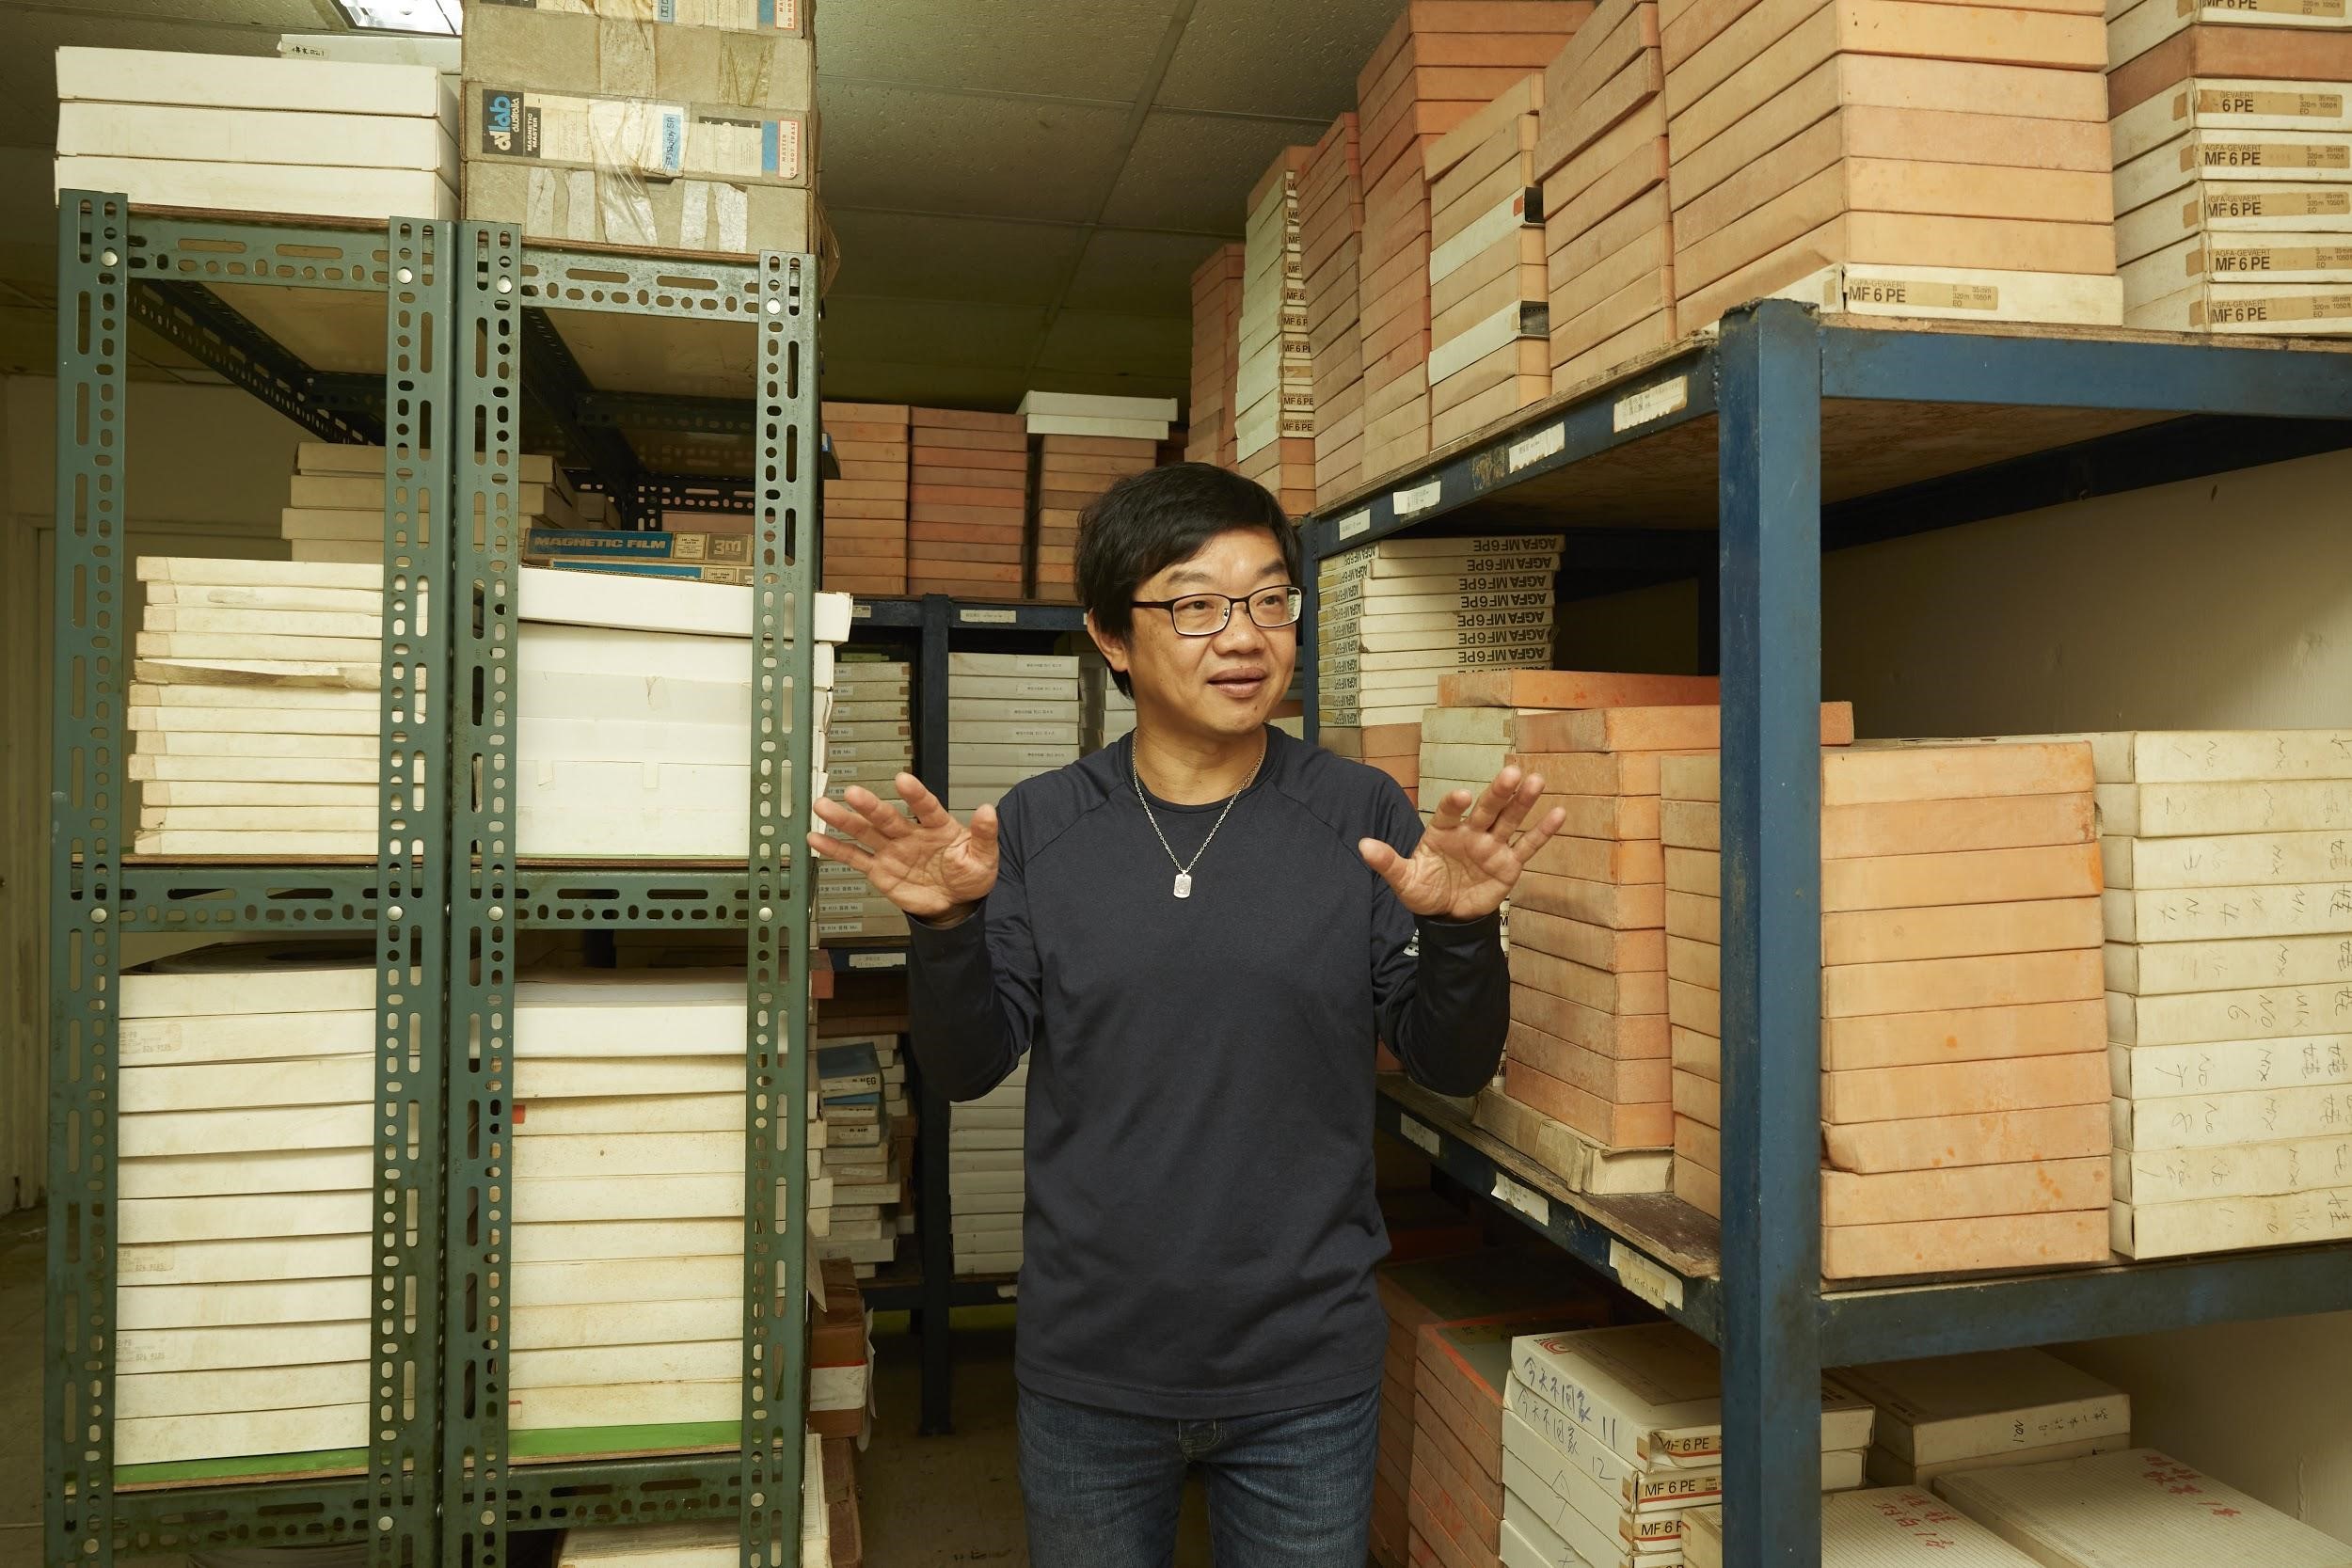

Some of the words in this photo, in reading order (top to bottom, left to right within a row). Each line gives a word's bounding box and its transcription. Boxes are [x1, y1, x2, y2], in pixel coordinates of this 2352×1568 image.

[2219, 90, 2254, 99] GEVAERT
[2222, 99, 2231, 112] 6
[2234, 99, 2254, 113] PE
[2204, 151, 2226, 166] MF
[2229, 151, 2237, 166] 6
[2241, 151, 2261, 166] PE
[2208, 202, 2227, 216] MF
[2230, 202, 2238, 216] 6
[2242, 201, 2262, 215] PE
[2216, 248, 2271, 257] AGFA-GEVAERT
[2216, 257, 2236, 271] MF
[2239, 257, 2248, 271] 6
[2250, 256, 2270, 270] PE
[1286, 292, 1298, 300] MF
[1299, 292, 1305, 300] 6
[1849, 286, 1870, 301] MF
[1873, 288, 1883, 302] 6
[1885, 288, 1906, 303] PE
[1283, 317, 1295, 325] MF
[1296, 317, 1302, 325] 6
[1303, 317, 1308, 325] P
[2213, 309, 2233, 323] MF
[2235, 308, 2244, 322] 6
[2248, 307, 2267, 321] PE
[1295, 344, 1301, 353] 6
[1283, 397, 1296, 405] MF
[1296, 397, 1302, 405] 6
[1304, 397, 1313, 405] PE
[1282, 422, 1294, 431] MF
[1295, 422, 1300, 431] 6
[534, 536, 623, 548] MAGNETIC
[627, 539, 667, 549] FILM
[713, 539, 741, 556] 3M
[1521, 538, 1557, 551] AGFA
[1516, 557, 1552, 569] AGFA
[1509, 576, 1547, 588] AGFA
[1511, 593, 1547, 606] AGFA
[1507, 611, 1545, 625] AGFA
[1509, 628, 1546, 641] AGFA
[1508, 647, 1545, 660] AGFA
[2227, 1005, 2251, 1022] 6
[1523, 1355, 1592, 1422] 今天不回家
[1517, 1386, 1581, 1456] 今天不回家
[1601, 1416, 1616, 1449] 11
[1682, 1438, 1691, 1451] 6
[1693, 1437, 1709, 1450] PE
[1591, 1456, 1616, 1481] 12
[1645, 1482, 1664, 1497] MF
[1668, 1481, 1677, 1494] 6
[1679, 1480, 1695, 1493] PE
[1641, 1523, 1661, 1536] MF
[1664, 1521, 1673, 1534] 6
[1676, 1520, 1681, 1532] P
